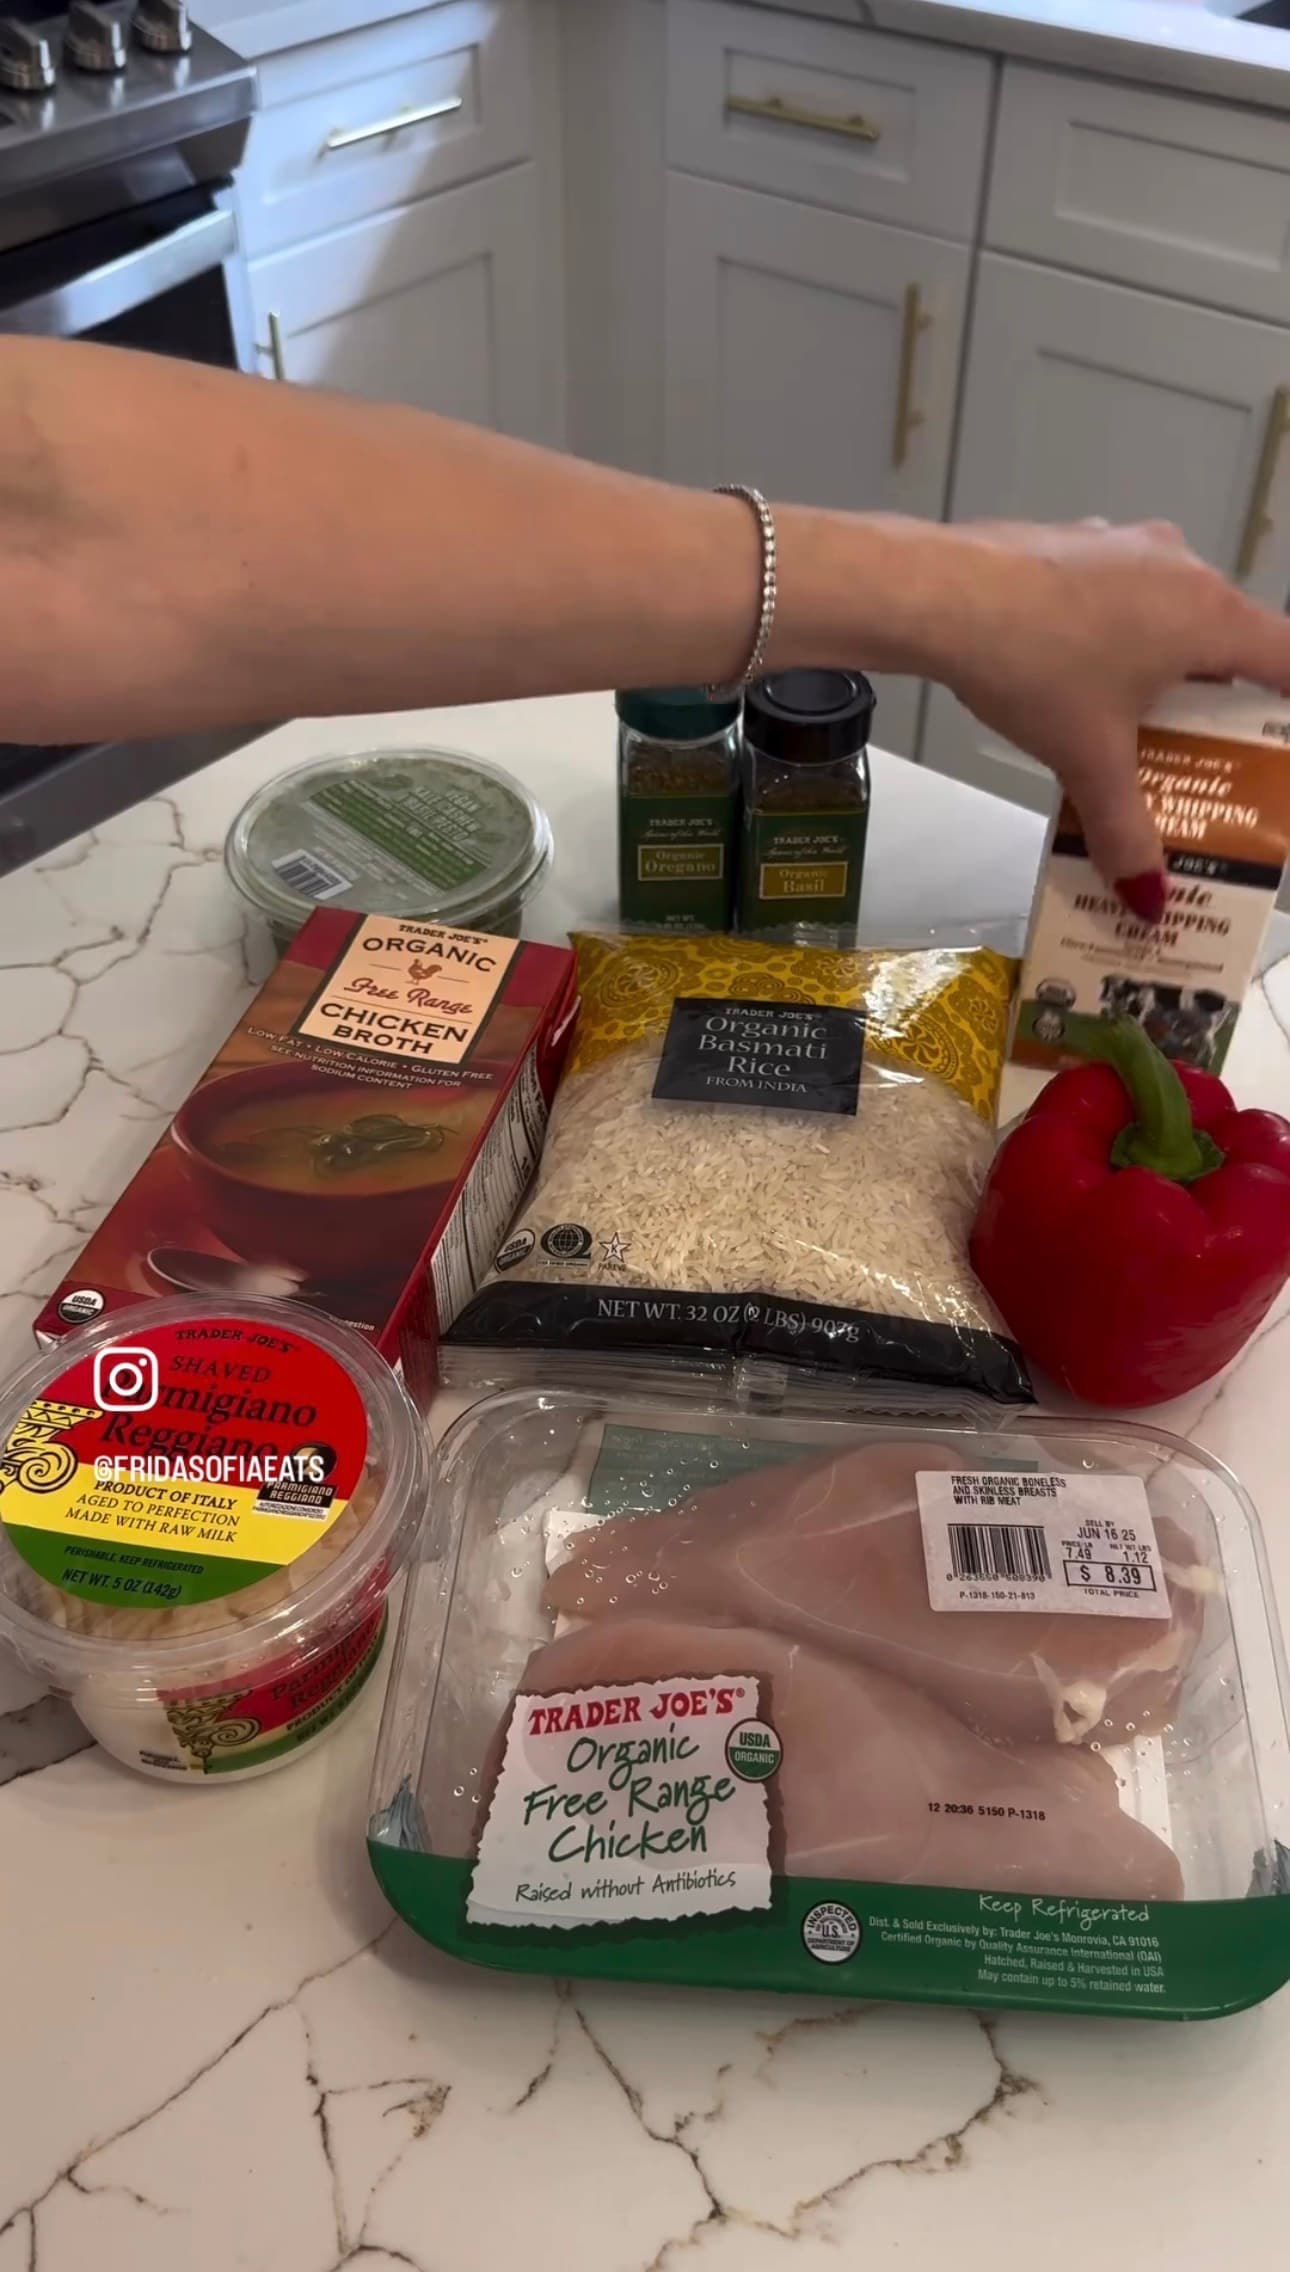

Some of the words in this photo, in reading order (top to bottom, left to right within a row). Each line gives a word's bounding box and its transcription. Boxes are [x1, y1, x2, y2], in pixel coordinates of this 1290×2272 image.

[650, 818, 685, 827] TRADER
[773, 837, 809, 845] TRADER
[655, 849, 705, 861] Organic
[644, 861, 716, 875] Oregano
[779, 868, 830, 880] Organic
[782, 878, 825, 893] Basil
[398, 923, 445, 940] TRADER
[362, 936, 498, 973] ORGANIC
[343, 977, 400, 1001] Free
[406, 987, 474, 1015] Range
[320, 1002, 469, 1043] CHICKEN
[724, 1007, 775, 1018] TRADER
[332, 1024, 433, 1055] BROTH
[704, 1016, 829, 1040] Organic
[698, 1033, 828, 1060] Basmati
[270, 1045, 295, 1057] SEE
[294, 1051, 356, 1073] NUTRITION
[357, 1064, 436, 1086] INFORMATION
[436, 1079, 462, 1088] FOR
[311, 1063, 356, 1080] SODIUM
[357, 1074, 413, 1091] CONTENT
[727, 1055, 792, 1078] Rice
[706, 1075, 754, 1089] FROM
[757, 1079, 808, 1093] INDIA
[72, 1294, 98, 1306] USDA
[598, 1298, 640, 1318] NET
[642, 1302, 681, 1320] WT.
[686, 1305, 708, 1322] 32
[712, 1304, 741, 1324] OZ
[763, 1307, 807, 1335] LBS)
[810, 1317, 861, 1343] 907g
[175, 1327, 243, 1342] TRADER
[247, 1333, 294, 1354] JOE'S
[169, 1354, 272, 1384] SHAVED
[98, 1411, 279, 1464] Reggiano
[951, 1475, 979, 1485] FRESH
[982, 1476, 1020, 1486] ORGANIC
[1022, 1477, 1067, 1488] BONELESS
[953, 1486, 971, 1495] AND
[973, 1486, 1016, 1496] SKINLESS
[1018, 1487, 1057, 1497] BREASTS
[93, 1480, 168, 1501] PRODUCT
[169, 1491, 192, 1503] OF
[193, 1494, 238, 1511] ITALY
[269, 1490, 323, 1505] REGGIANO
[954, 1496, 979, 1505] WITH
[981, 1496, 996, 1505] RIB
[998, 1497, 1022, 1506] MEAT
[76, 1494, 119, 1509] AGED
[123, 1500, 145, 1514] TO
[146, 1503, 241, 1527] PERFECTION
[65, 1507, 112, 1525] MADE
[116, 1515, 156, 1532] WITH
[159, 1522, 196, 1537] RAW
[197, 1528, 238, 1543] MILK
[1077, 1527, 1101, 1539] JUN
[1104, 1528, 1119, 1540] 16
[1121, 1529, 1137, 1541] 25
[118, 1554, 142, 1566] KEEP
[142, 1558, 205, 1575] REFRIGERATED
[1065, 1547, 1092, 1560] 7.49
[1123, 1551, 1149, 1564] 1.12
[62, 1567, 89, 1585] NET
[89, 1572, 110, 1589] WT.
[112, 1577, 121, 1590] 5
[123, 1578, 142, 1593] OZ
[142, 1580, 183, 1601] (142g)
[1080, 1564, 1092, 1583] $
[1104, 1565, 1142, 1585] 8.39
[1084, 1588, 1111, 1597] TOTAL
[1113, 1590, 1140, 1599] PRICE
[528, 1696, 642, 1735] TRADER
[739, 1731, 771, 1749] USDA
[566, 1722, 701, 1791] Organic
[733, 1750, 776, 1765] ORGANIC
[522, 1784, 609, 1826] Free
[627, 1774, 737, 1827] Range
[928, 1801, 941, 1813] 12
[944, 1803, 974, 1815] 20:36
[978, 1805, 1005, 1817] 5150
[1008, 1807, 1046, 1821] P-1318
[548, 1819, 708, 1863] Chicken
[515, 1881, 573, 1903] Raised
[581, 1875, 645, 1900] without
[651, 1867, 737, 1895] Antibiotics
[807, 1905, 857, 1931] INSPECTED
[979, 1893, 1022, 1922] Keep
[1032, 1896, 1150, 1931] Refrigerated
[869, 1915, 890, 1928] Dist.
[903, 1918, 924, 1931] Sold
[926, 1920, 979, 1937] Exclusively
[983, 1925, 998, 1938] by:
[1000, 1927, 1031, 1940] Trader
[1034, 1930, 1060, 1942] Joe's
[1062, 1932, 1110, 1947] Monrovia,
[1113, 1935, 1129, 1946] CA
[1129, 1936, 1159, 1948] 91016
[881, 1931, 922, 1944] Certified
[924, 1934, 961, 1948] Organic
[964, 1938, 976, 1951] by
[979, 1938, 1013, 1954] Quality
[1016, 1943, 1068, 1957] Assurance
[1071, 1947, 1134, 1962] International
[984, 1953, 1028, 1969] Hatched,
[1030, 1957, 1065, 1972] Raised
[1078, 1962, 1128, 1976] Harvested
[1143, 1966, 1164, 1978] USA
[978, 1968, 1000, 1984] May
[1001, 1971, 1039, 1985] contain
[1042, 1975, 1055, 1988] up
[1057, 1976, 1068, 1987] to
[1070, 1977, 1087, 1990] 5%
[1089, 1981, 1132, 1992] retained
[1135, 1983, 1167, 1994] water.
